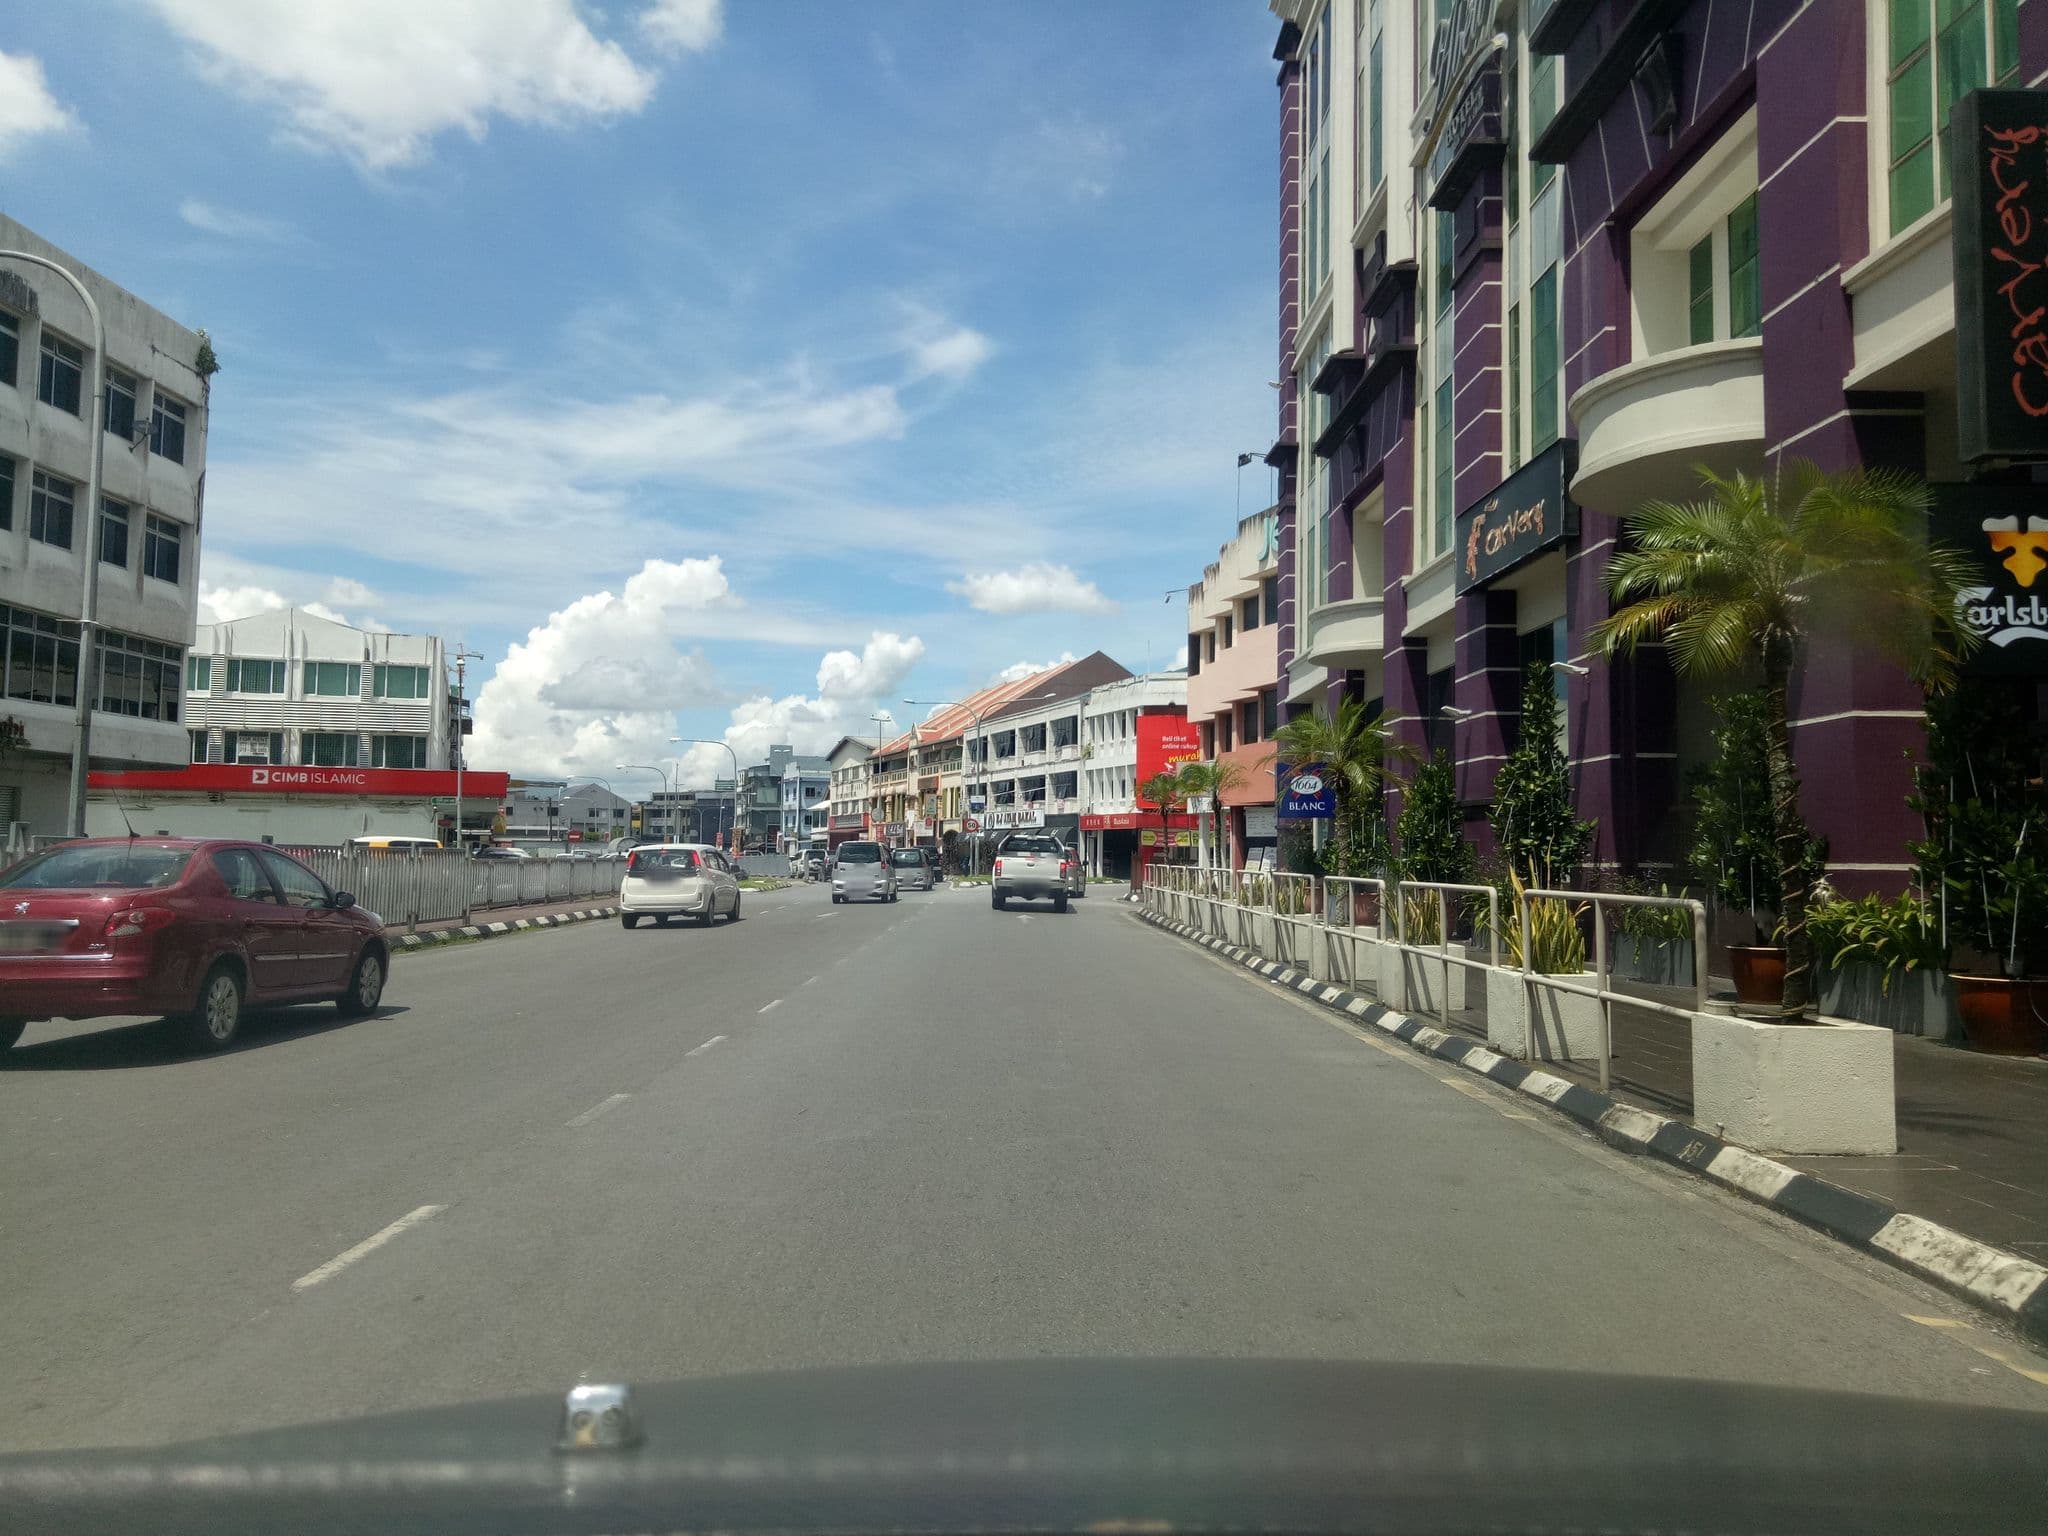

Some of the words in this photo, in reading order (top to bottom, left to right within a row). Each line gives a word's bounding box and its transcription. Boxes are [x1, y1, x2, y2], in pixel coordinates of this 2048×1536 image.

[271, 771, 308, 783] CIMB
[310, 772, 366, 785] ISLAMIC
[1289, 801, 1326, 811] BLANC
